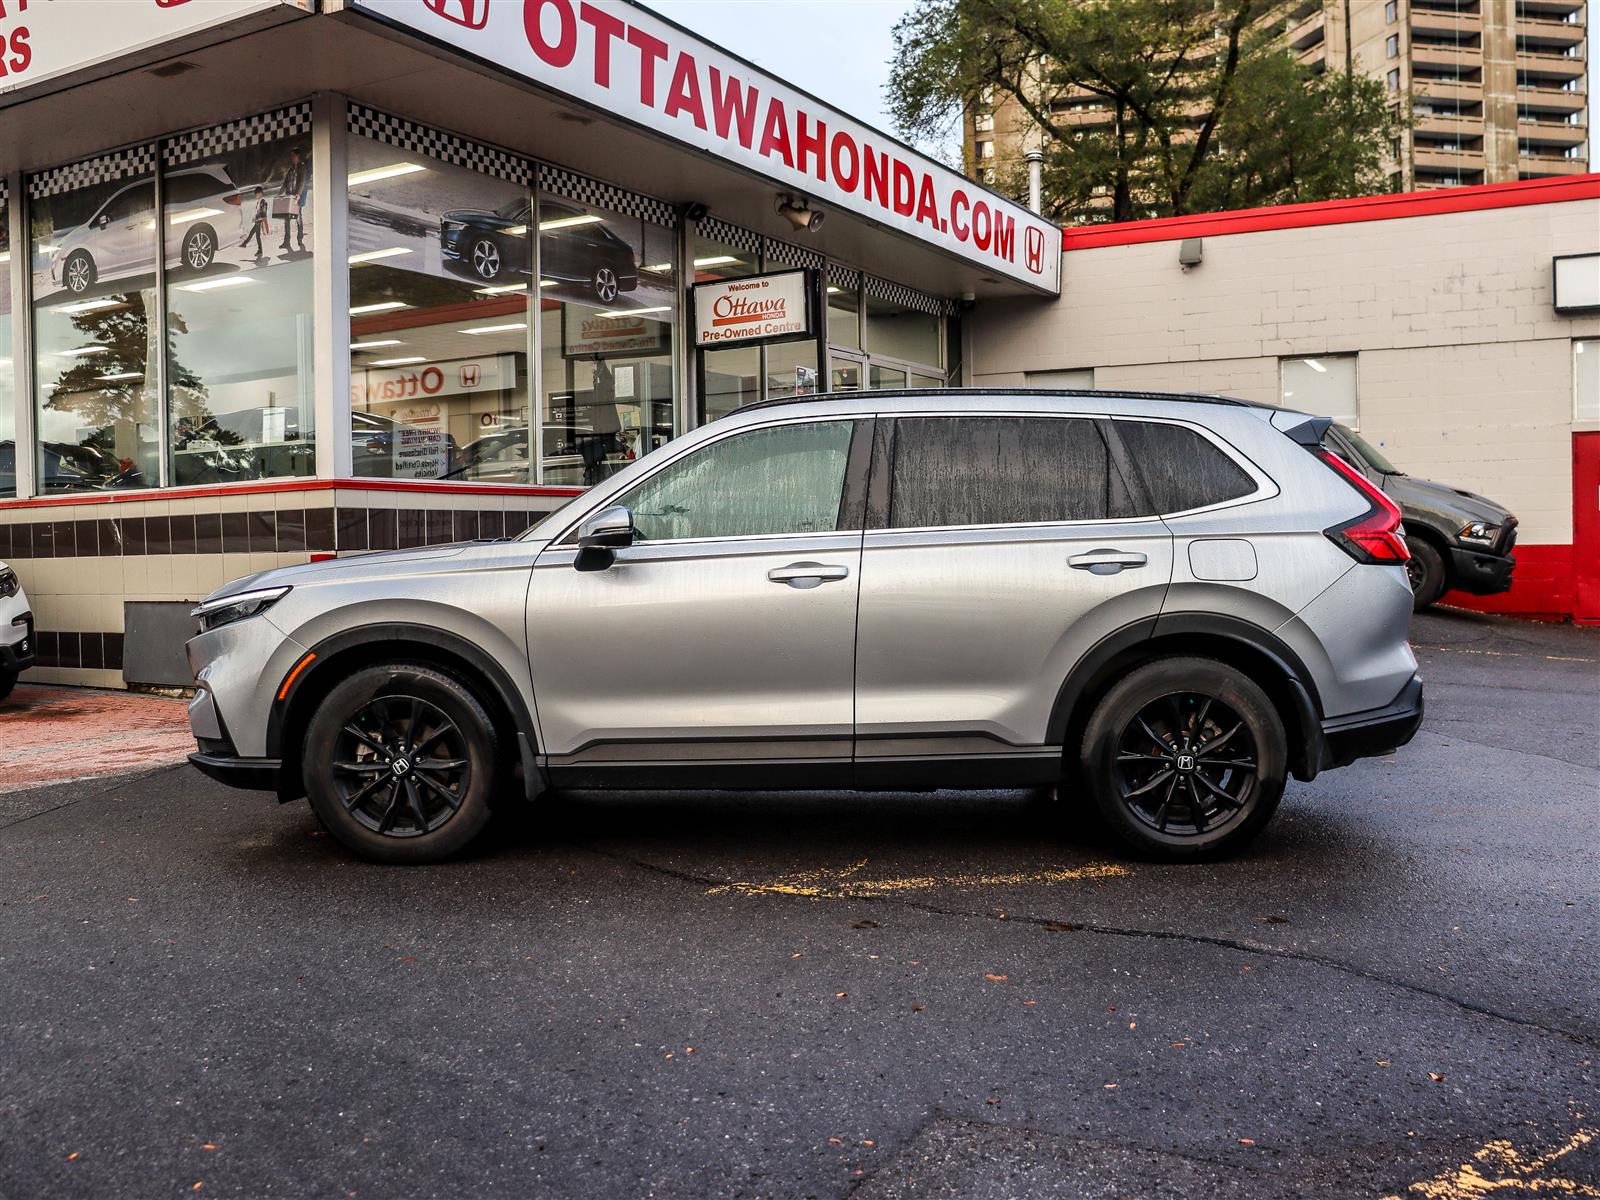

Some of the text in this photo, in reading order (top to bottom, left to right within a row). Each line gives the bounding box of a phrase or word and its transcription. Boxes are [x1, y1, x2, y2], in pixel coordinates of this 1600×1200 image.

[523, 0, 1015, 263] OTTAWAHONDA.COM
[728, 280, 769, 292] Welcome to
[713, 294, 786, 318] Ottawa
[762, 311, 784, 320] HONDA
[703, 321, 801, 342] Pre-Owned Centre
